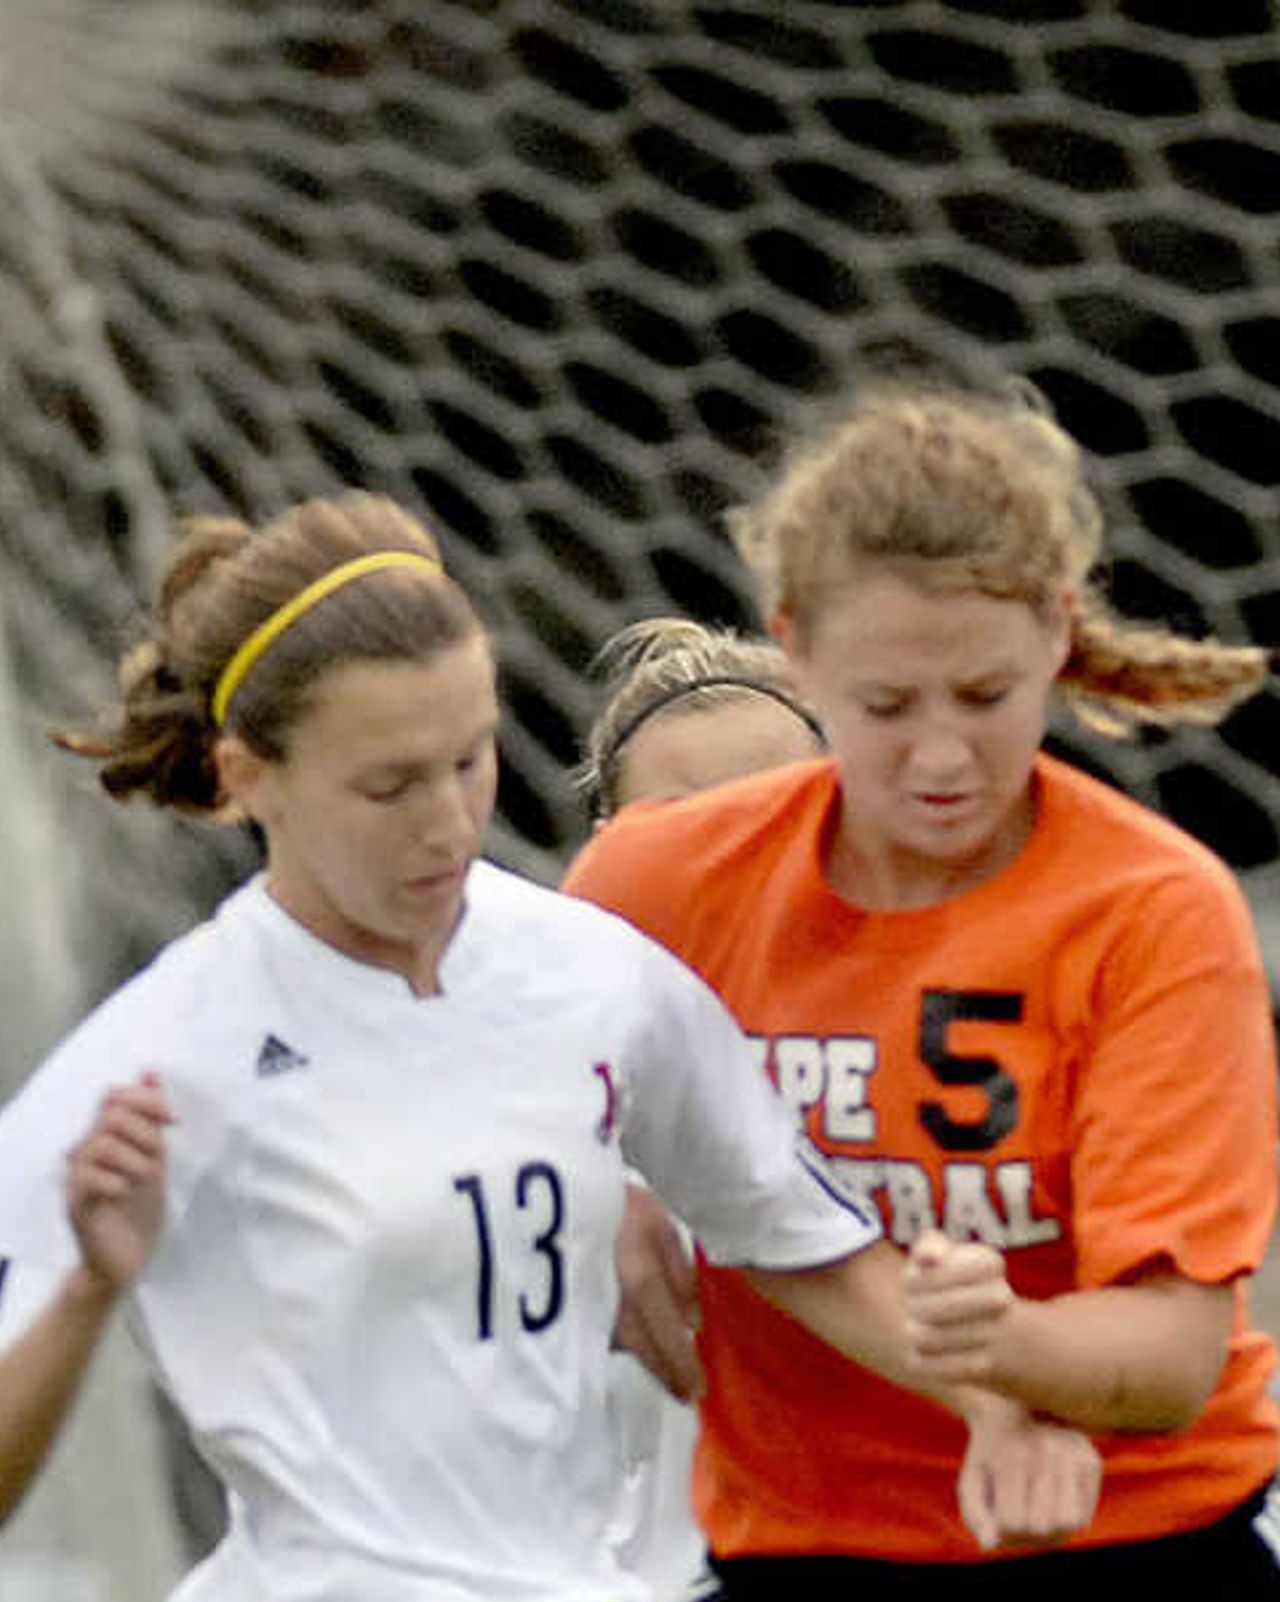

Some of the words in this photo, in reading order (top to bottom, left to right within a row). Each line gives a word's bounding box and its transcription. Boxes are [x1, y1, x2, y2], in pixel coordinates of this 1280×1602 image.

[745, 1033, 878, 1143] PE
[918, 990, 1024, 1151] 5
[452, 1160, 566, 1343] 13
